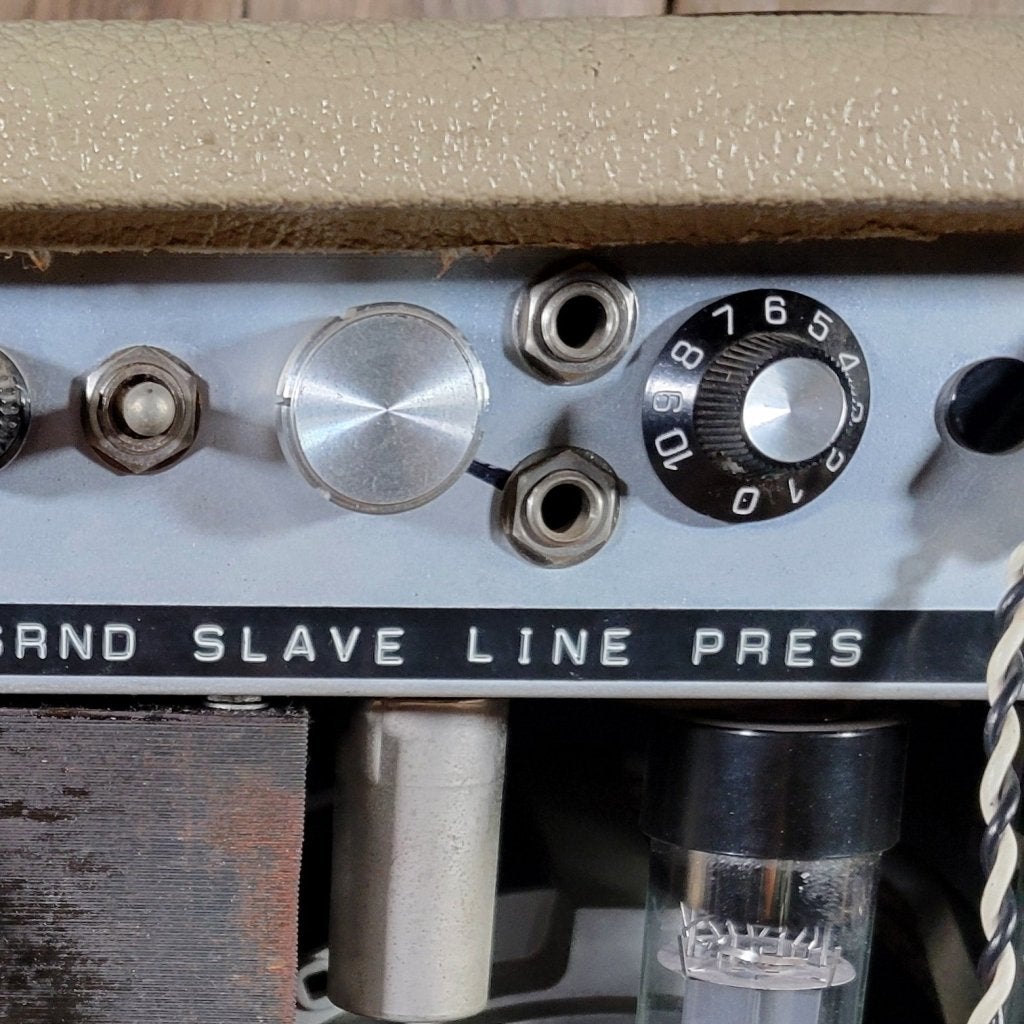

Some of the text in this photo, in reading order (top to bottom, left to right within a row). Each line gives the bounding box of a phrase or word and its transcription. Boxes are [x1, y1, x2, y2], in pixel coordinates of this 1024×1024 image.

[712, 304, 733, 335] 7
[765, 296, 787, 325] 6
[807, 309, 834, 342] 5
[670, 340, 704, 370] 8
[652, 390, 683, 413] 9
[655, 428, 694, 471] 10
[732, 486, 760, 515] 0
[788, 477, 804, 503] 1
[193, 624, 405, 666] SLAVE
[467, 626, 632, 666] LINE
[692, 628, 864, 668] PRES
